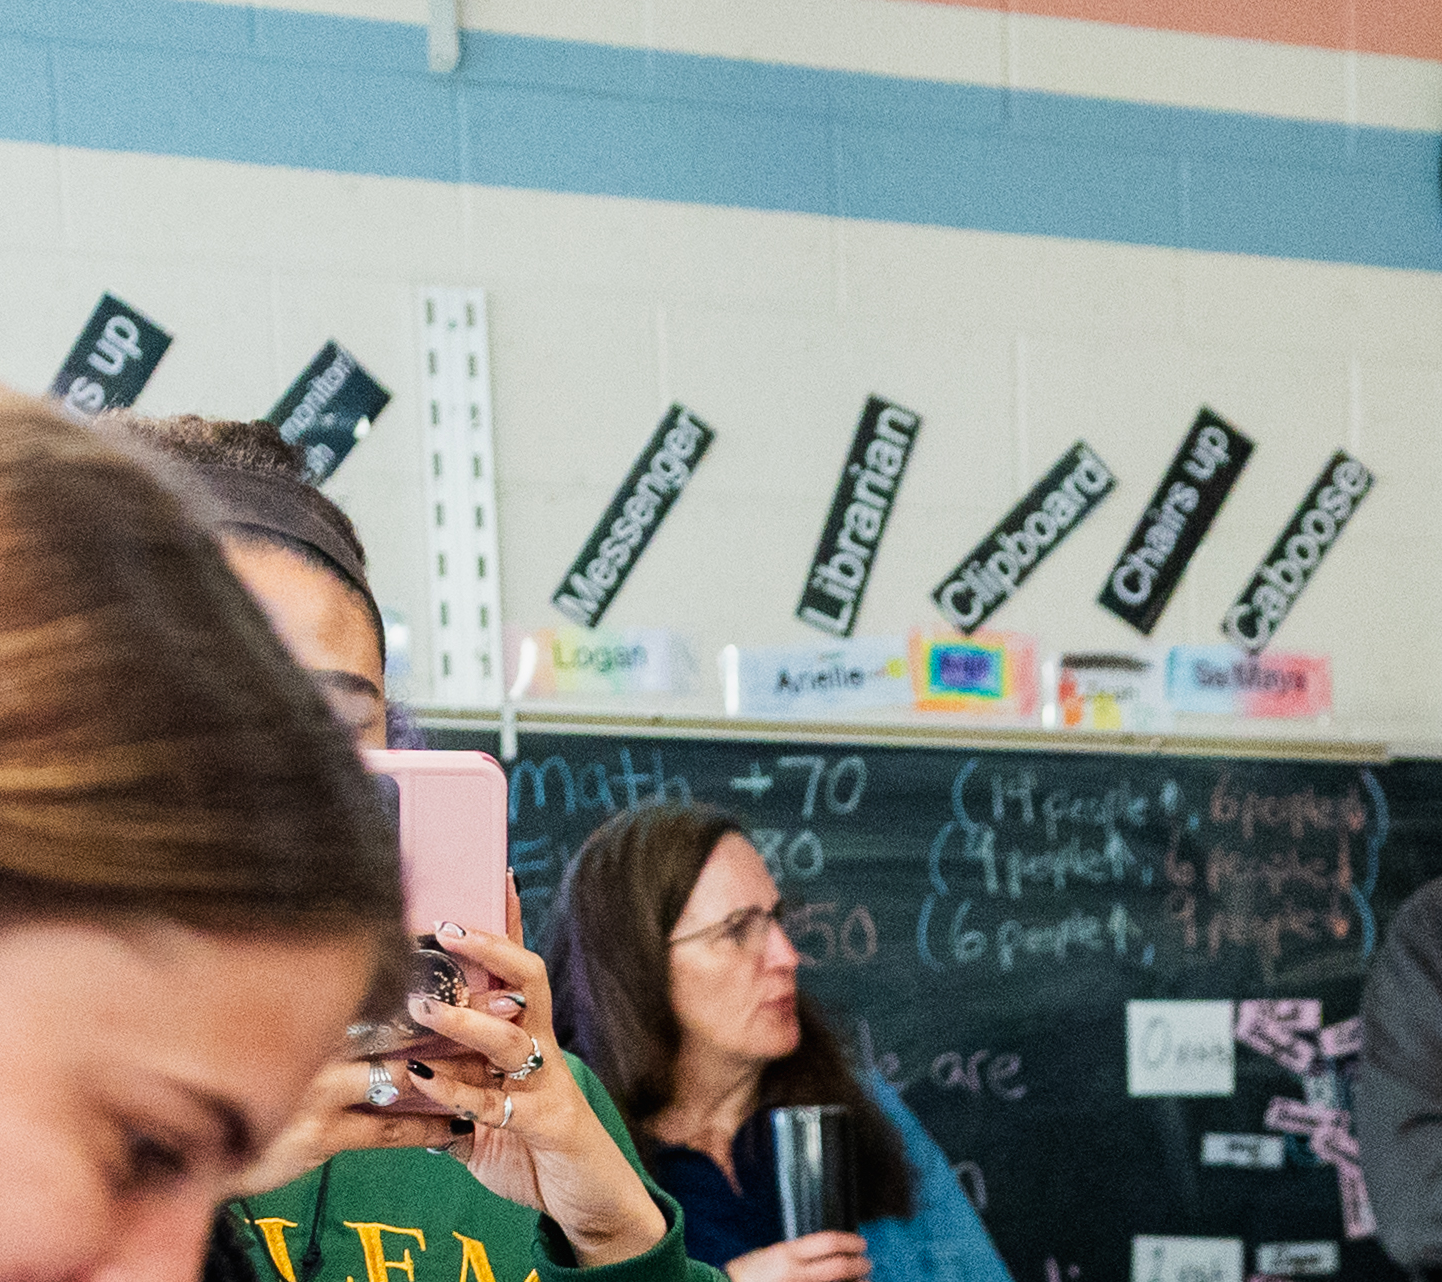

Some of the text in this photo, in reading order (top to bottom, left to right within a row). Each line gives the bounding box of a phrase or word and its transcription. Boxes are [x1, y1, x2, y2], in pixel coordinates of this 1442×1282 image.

[89, 313, 141, 372] up
[554, 412, 706, 626] Messenger
[800, 405, 921, 634] Librarian
[938, 454, 1111, 629] Clipboard
[1110, 425, 1232, 607] Chairs up
[1227, 458, 1370, 651] Caboose
[552, 635, 648, 674] Logan
[510, 747, 693, 825] Math
[930, 1049, 1027, 1101] are
